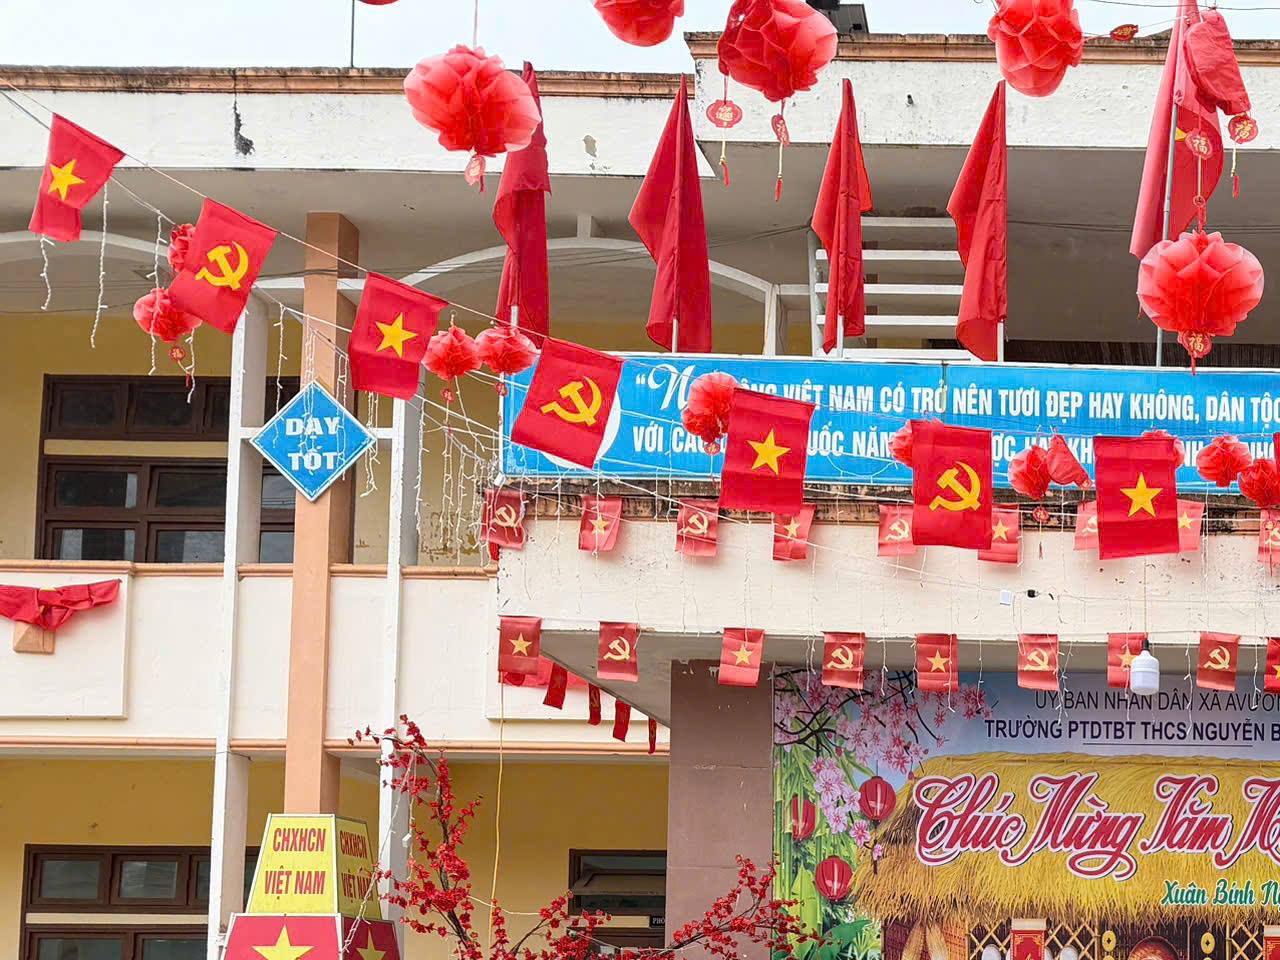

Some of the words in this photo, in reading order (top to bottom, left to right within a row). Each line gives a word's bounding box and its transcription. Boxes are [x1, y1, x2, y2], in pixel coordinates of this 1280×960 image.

[829, 386, 878, 413] NAM
[880, 381, 906, 413] CÓ
[911, 380, 947, 414] TRỞ
[953, 383, 993, 415] NÊN
[998, 387, 1041, 417] TƯƠI
[1046, 390, 1084, 424] ĐẸP
[1089, 391, 1124, 420] HAY
[1130, 388, 1200, 423] KHÔNG,
[1206, 391, 1245, 422] DÂN
[632, 421, 664, 453] VỚI
[808, 421, 844, 457] UỐC
[1064, 691, 1098, 710] BAN
[1158, 689, 1194, 711] DÂN
[1199, 690, 1219, 711] XÃ
[985, 715, 1062, 739] TRƯỜNG
[1068, 720, 1136, 740] PTDTBT
[1141, 721, 1187, 741] THCS
[1193, 718, 1265, 742] NGUYỄN
[273, 827, 326, 852] CHXHCN
[914, 771, 1026, 867] Chúc
[1000, 772, 1143, 881] Mừng
[1140, 772, 1233, 858] Năm
[264, 866, 293, 900] VIỆT
[295, 870, 326, 895] NAM
[1161, 879, 1209, 905] Xuân
[1214, 879, 1254, 906] Bính
